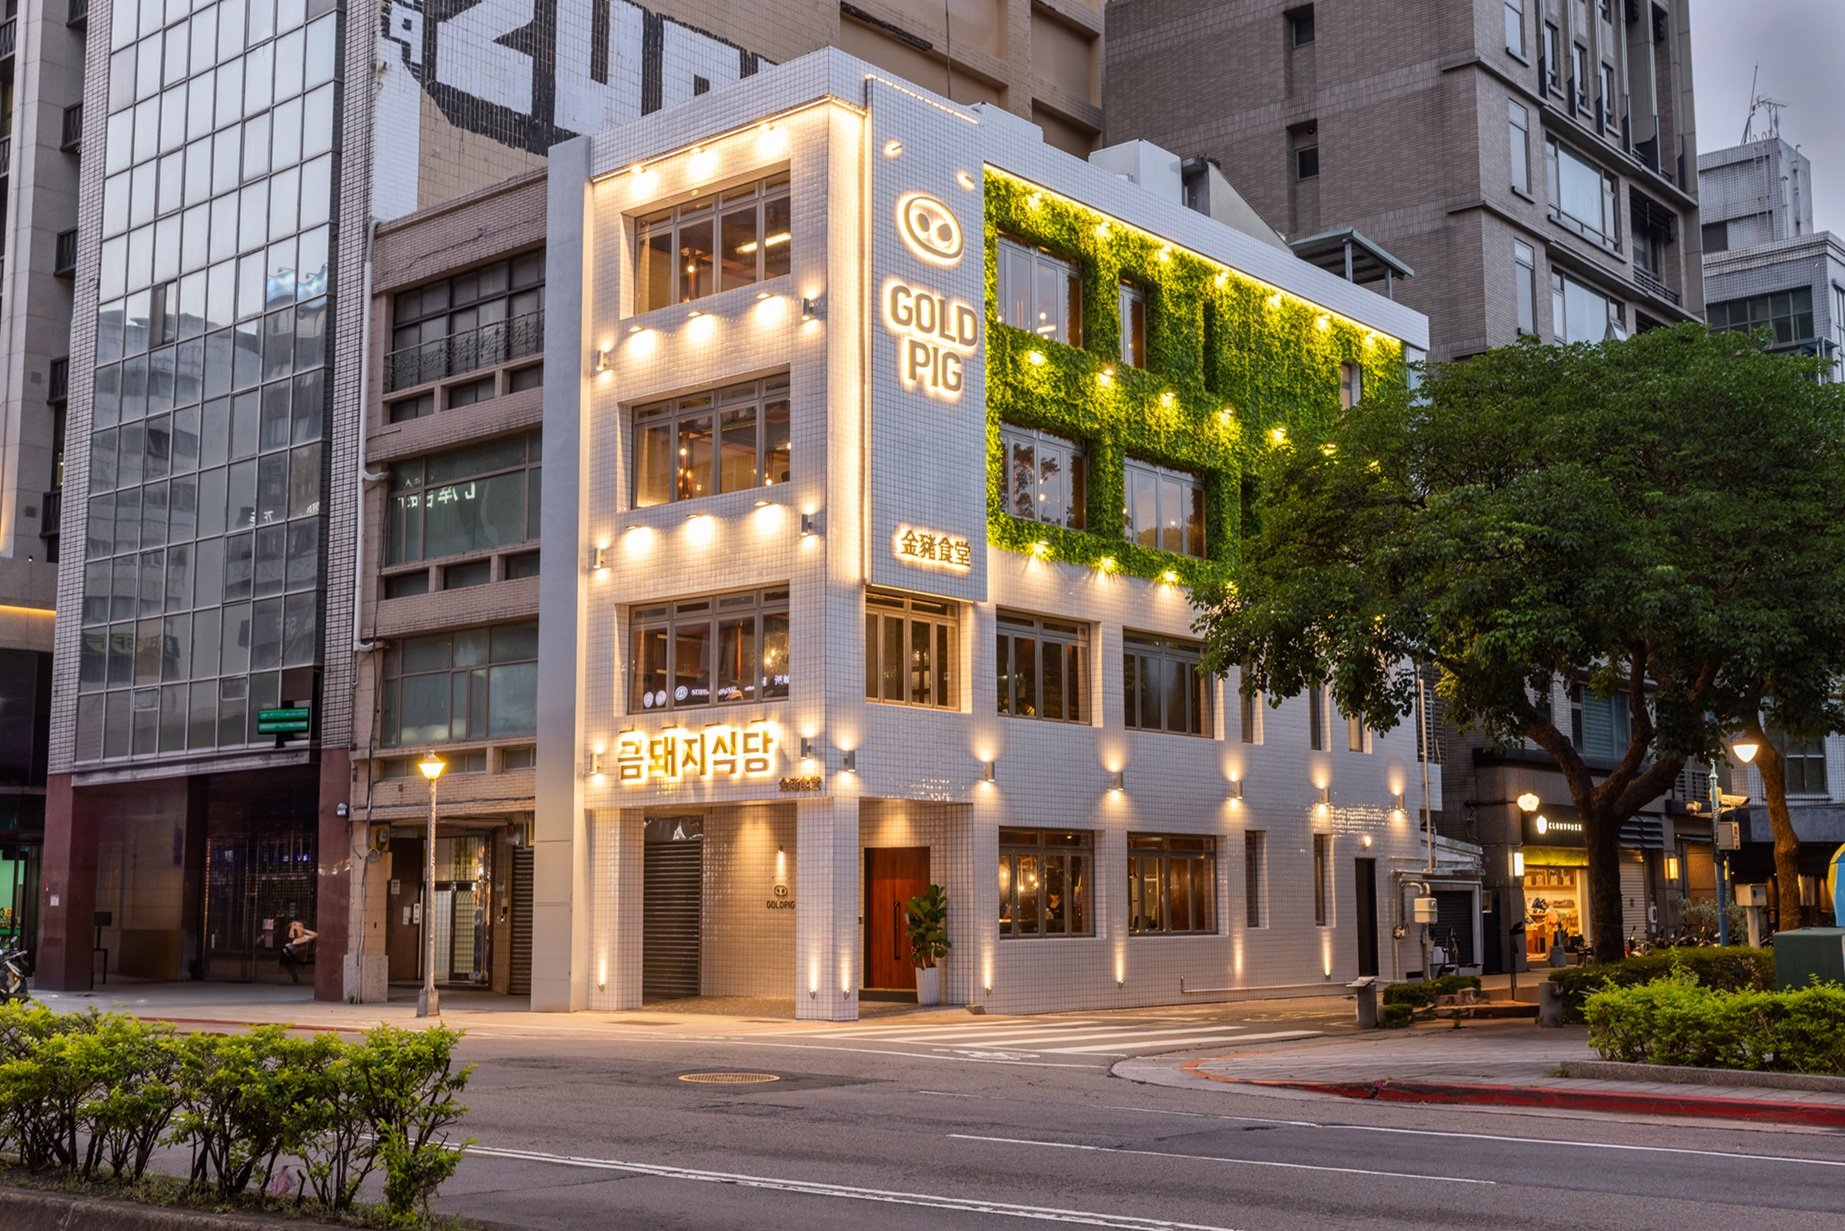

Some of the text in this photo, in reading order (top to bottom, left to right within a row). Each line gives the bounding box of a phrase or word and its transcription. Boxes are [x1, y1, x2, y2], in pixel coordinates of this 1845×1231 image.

[890, 285, 978, 347] GOLD
[908, 339, 963, 392] PIG
[900, 530, 971, 567] 金豬食堂
[617, 731, 774, 780] 금돼지식당
